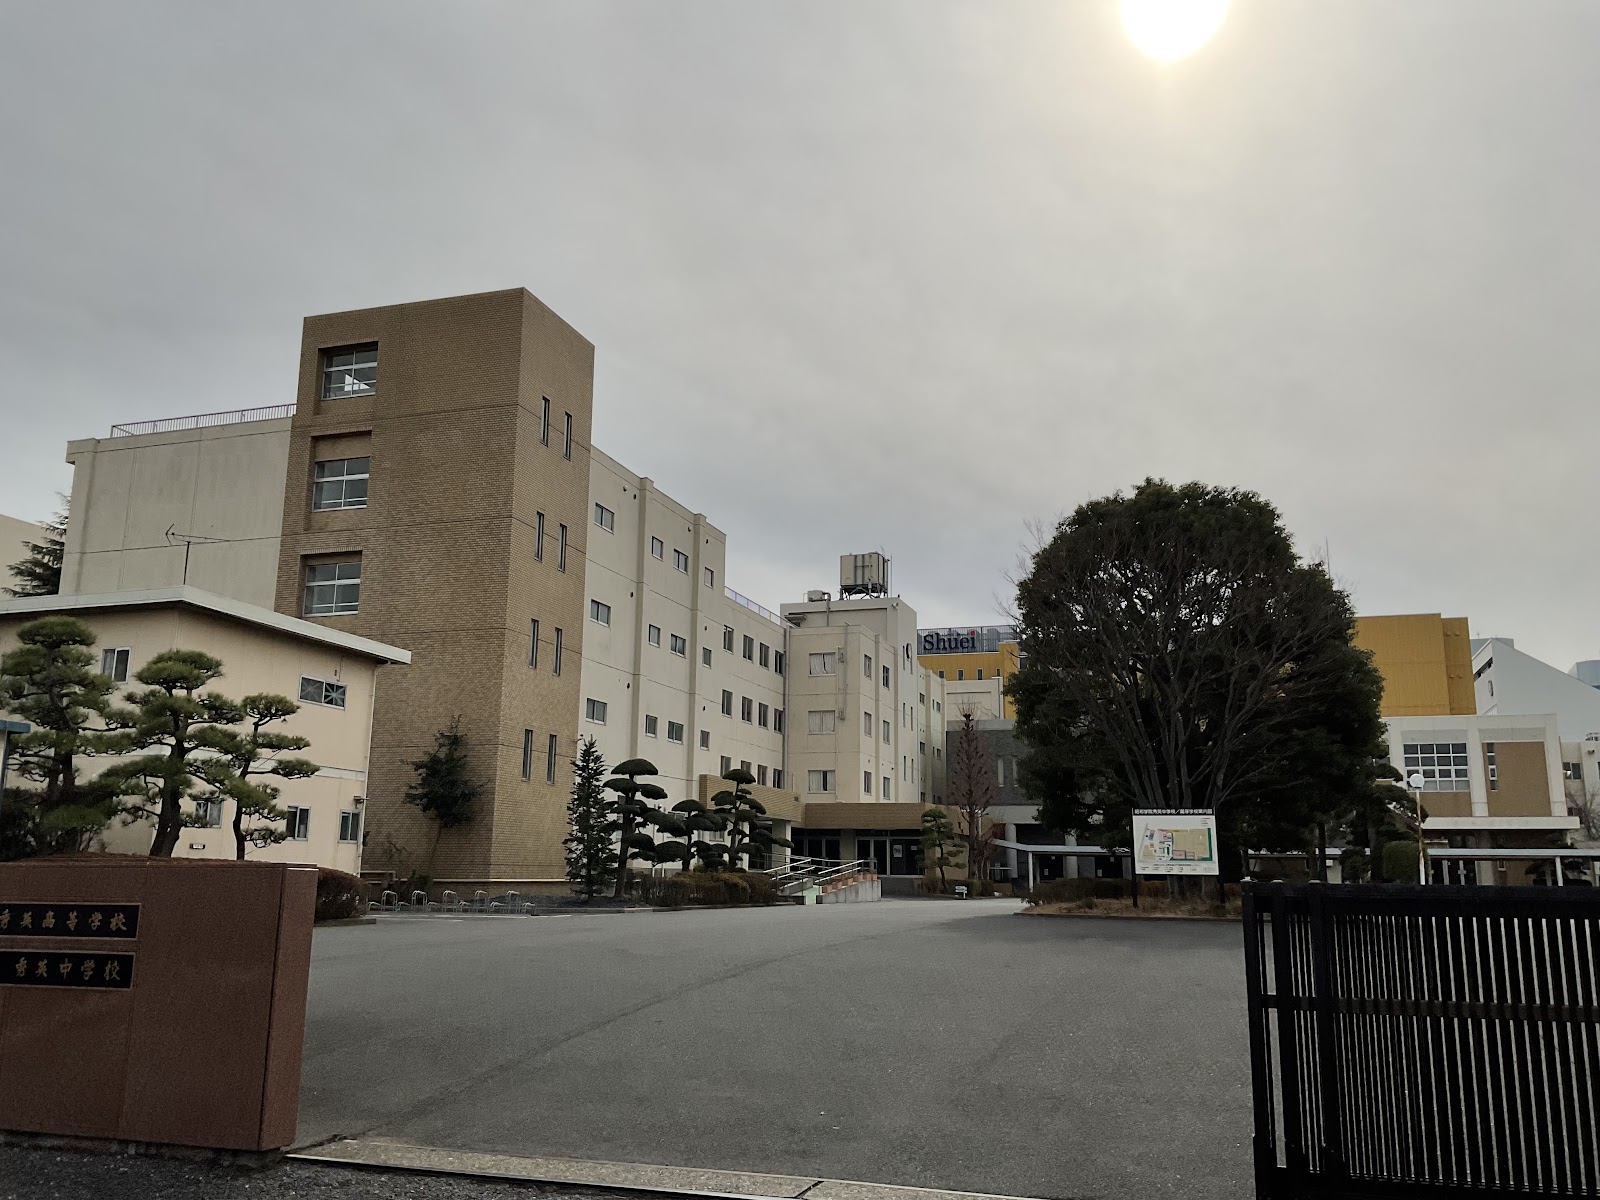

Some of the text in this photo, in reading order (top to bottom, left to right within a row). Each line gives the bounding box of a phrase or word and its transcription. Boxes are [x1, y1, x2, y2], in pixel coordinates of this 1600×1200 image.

[923, 630, 976, 651] Shuei
[15, 956, 121, 981] 秀英中学校
